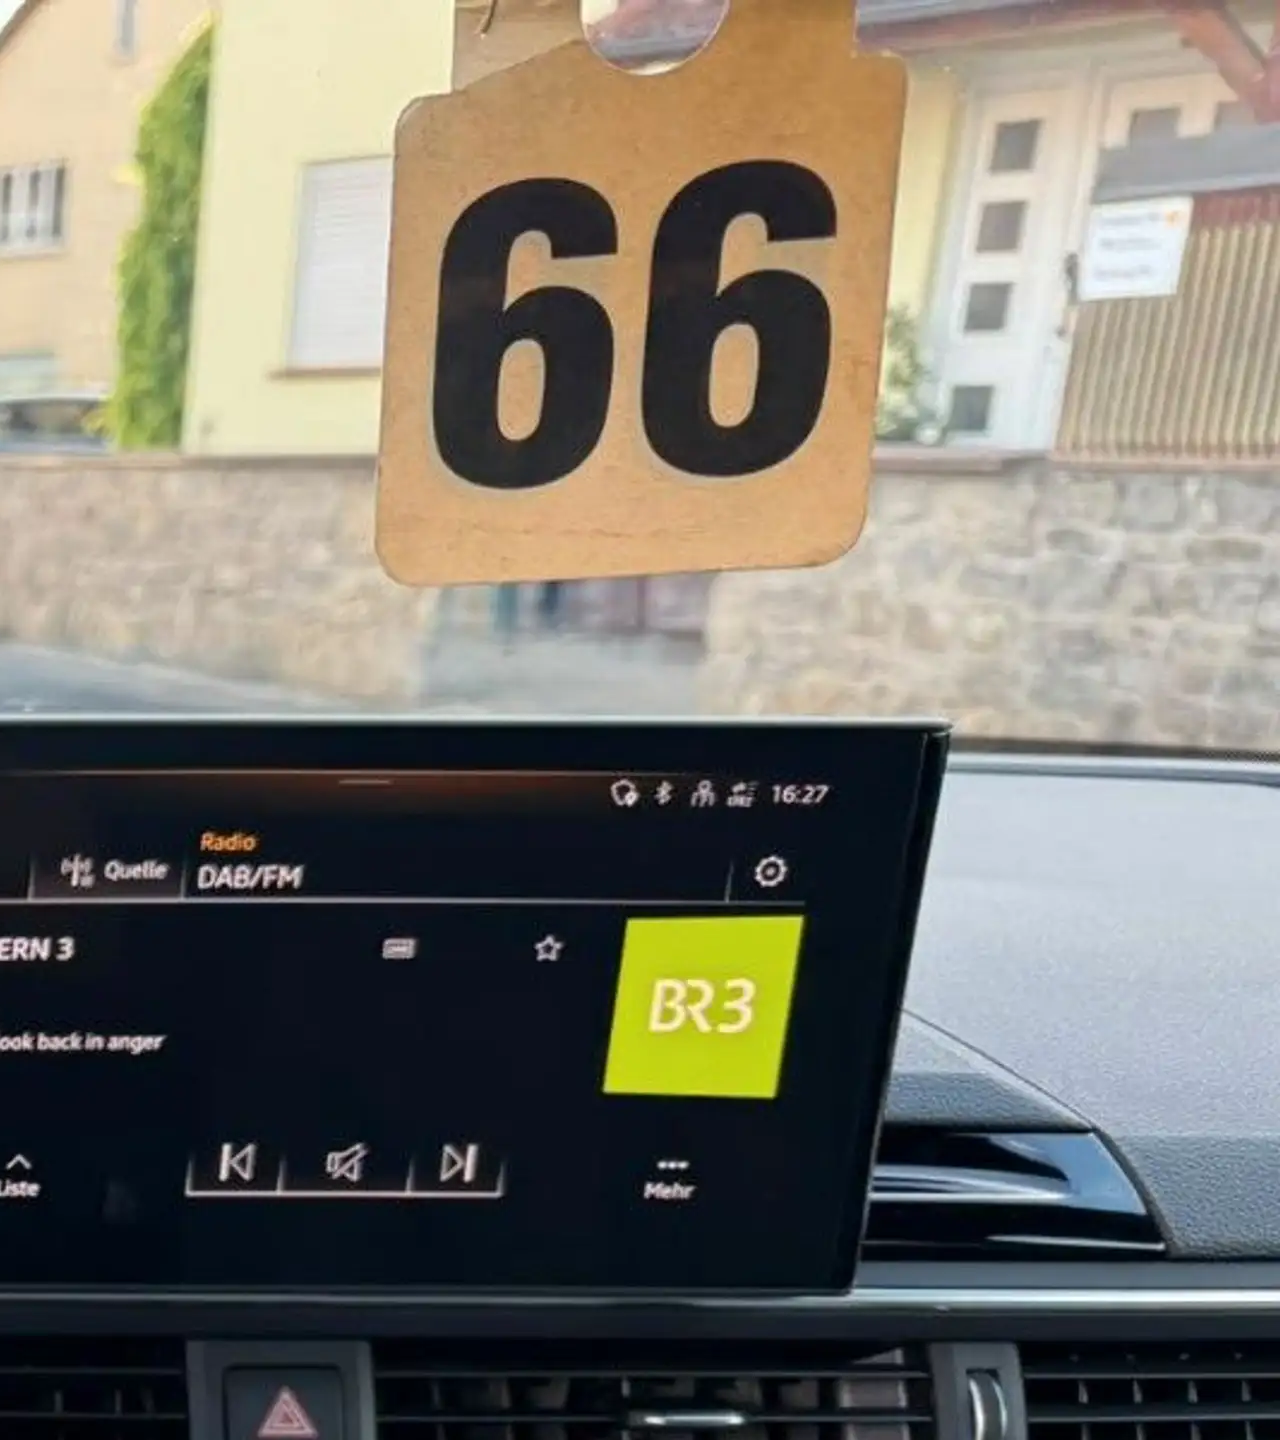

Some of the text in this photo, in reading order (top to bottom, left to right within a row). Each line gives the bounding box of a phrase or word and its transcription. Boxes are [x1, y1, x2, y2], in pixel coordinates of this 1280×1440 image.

[433, 158, 838, 490] 66
[772, 784, 831, 804] 16:27
[200, 832, 257, 852] Radio
[104, 860, 169, 881] Quelle
[197, 864, 304, 890] DAB/FM
[56, 937, 75, 960] 3
[37, 1032, 81, 1051] back
[84, 1033, 104, 1050] in
[107, 1034, 167, 1054] anger
[644, 1182, 697, 1200] Mehr
